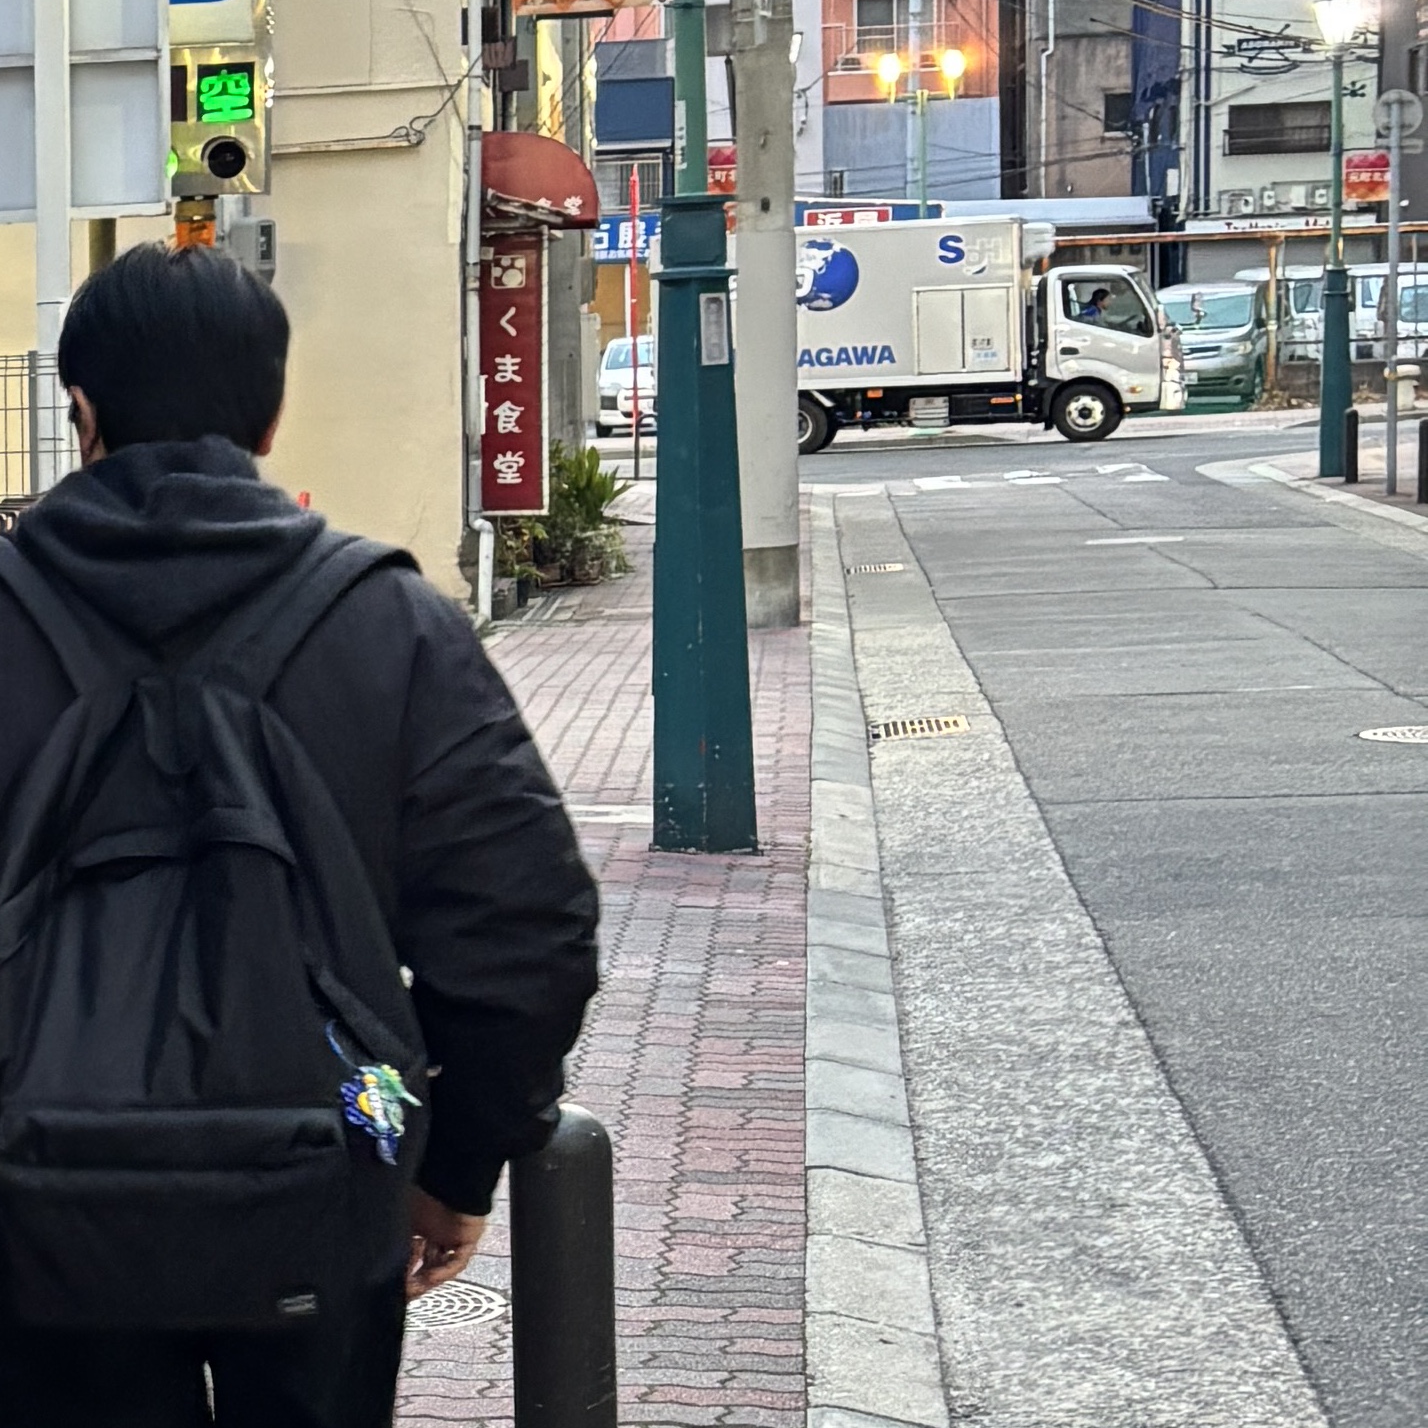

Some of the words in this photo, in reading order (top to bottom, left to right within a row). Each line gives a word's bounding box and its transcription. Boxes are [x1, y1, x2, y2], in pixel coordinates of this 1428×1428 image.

[199, 70, 254, 123] 空
[493, 306, 525, 484] くま食堂
